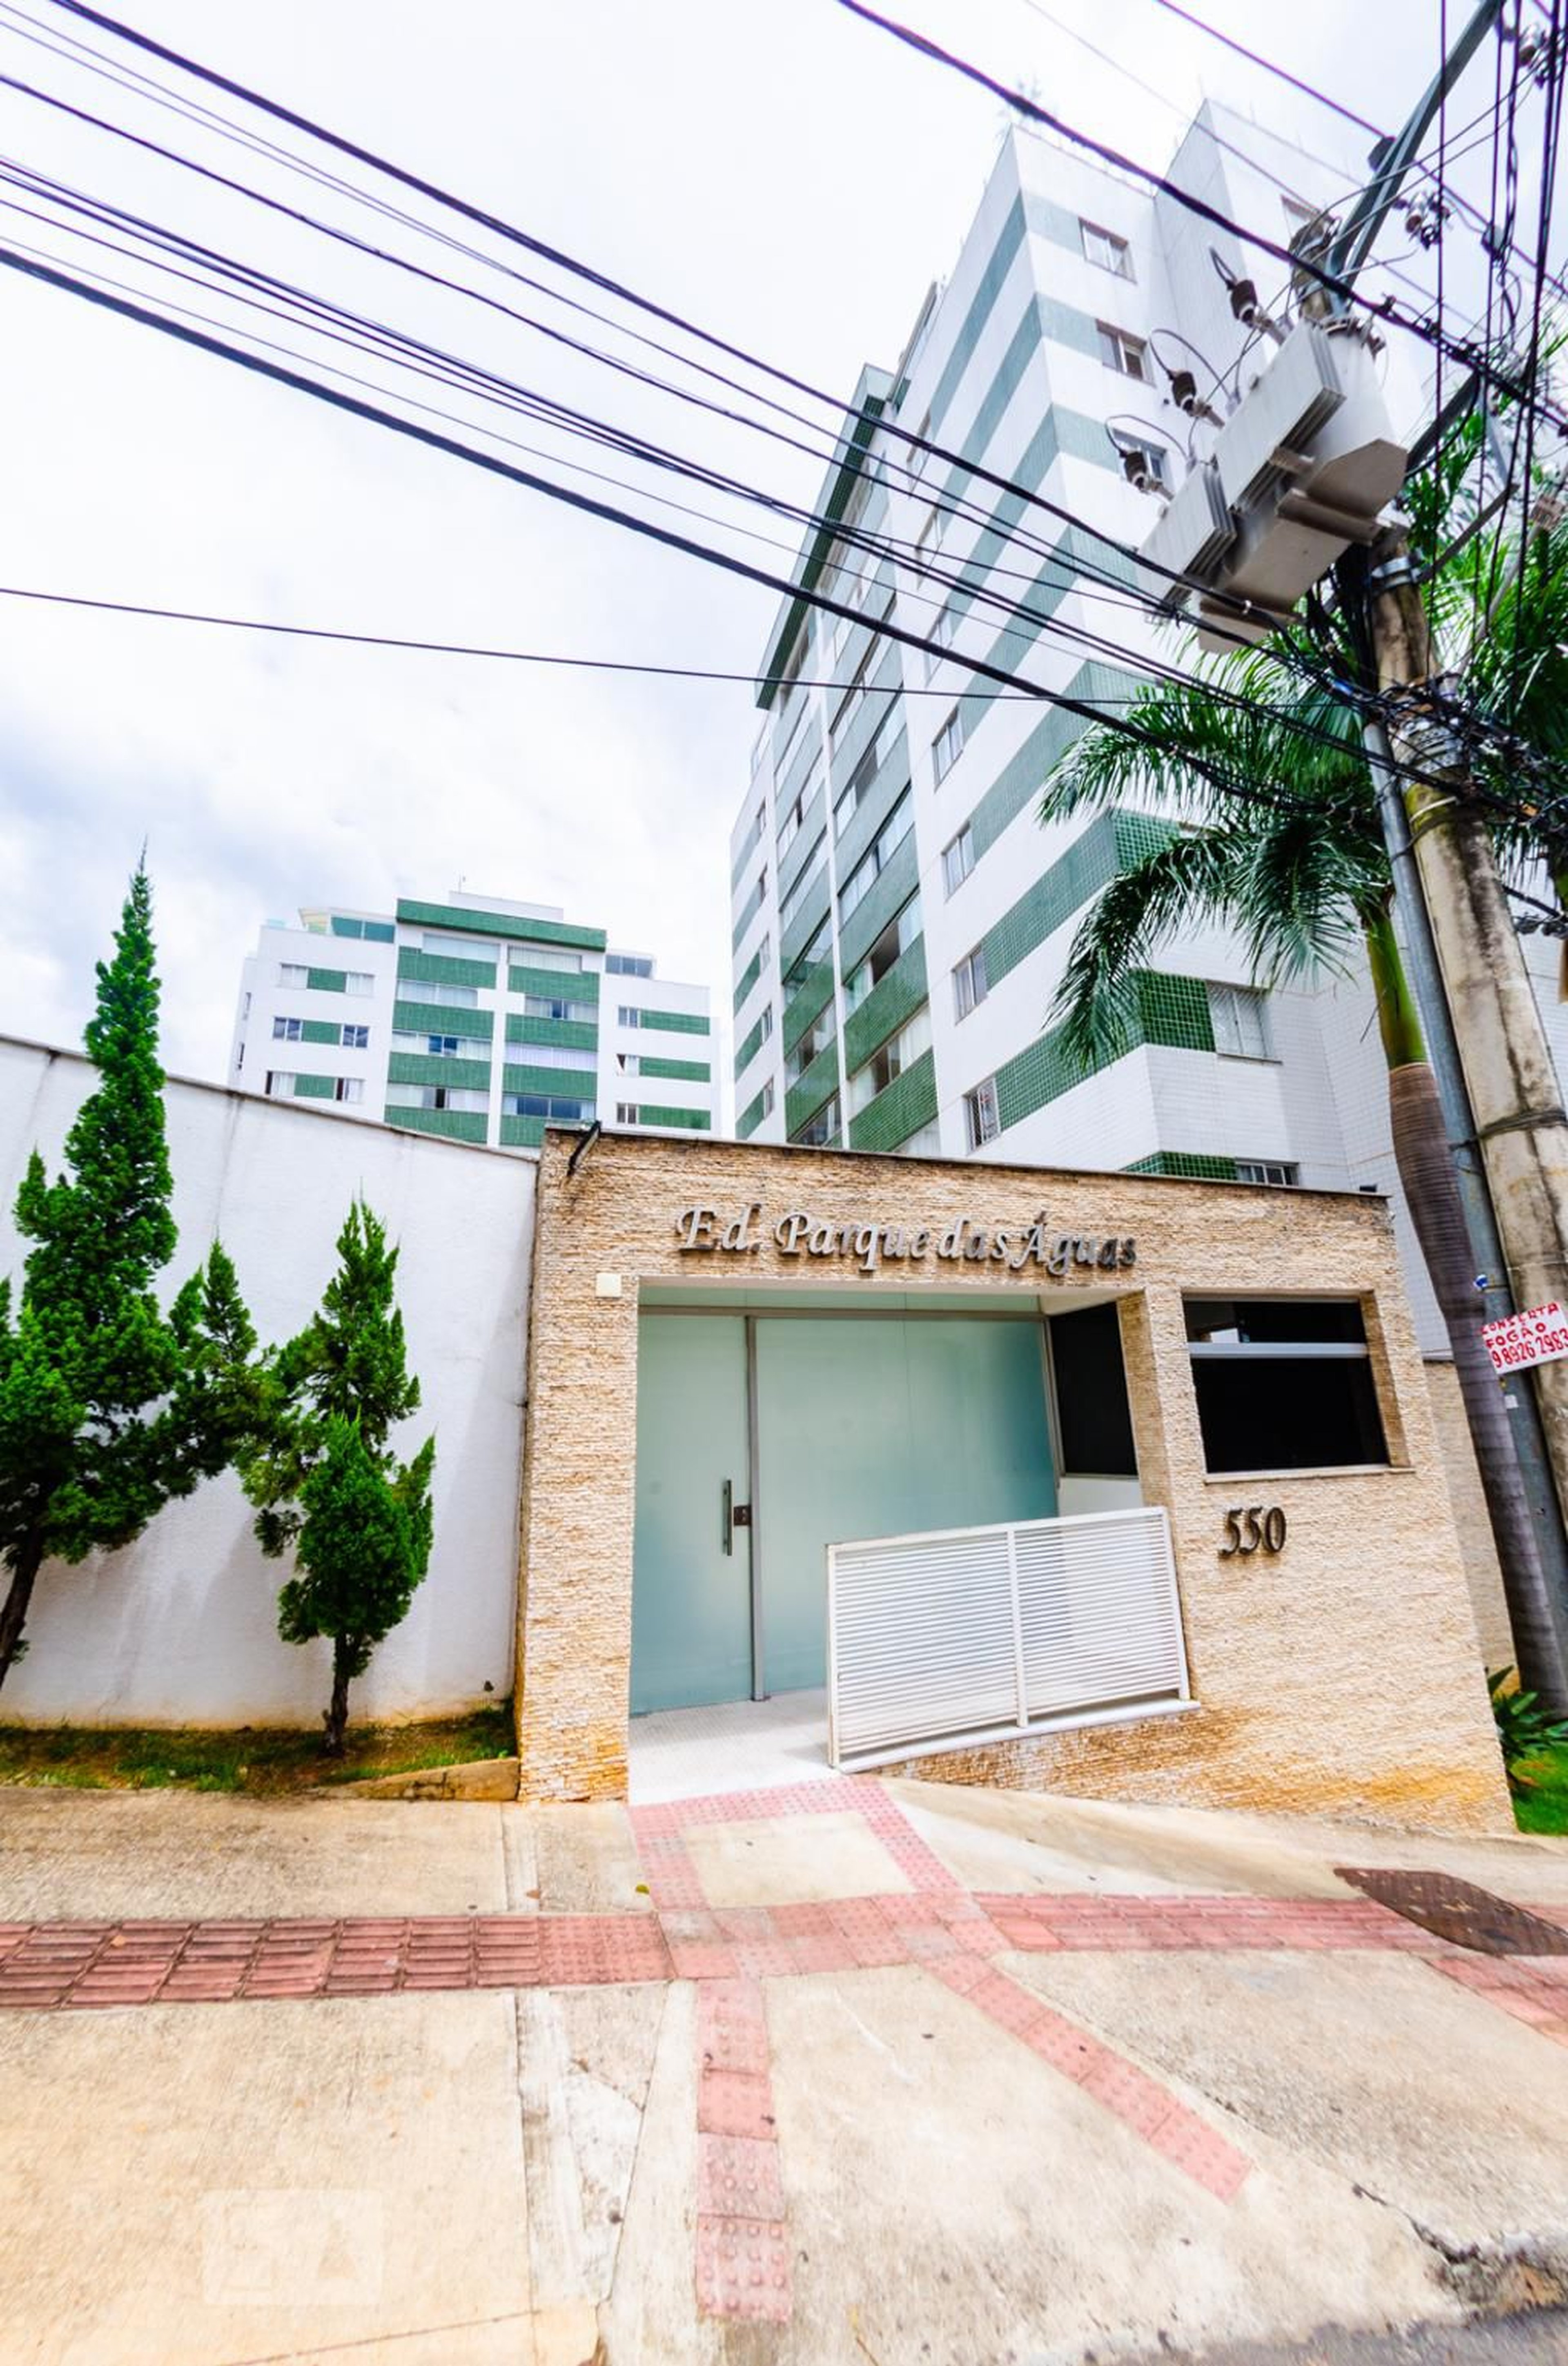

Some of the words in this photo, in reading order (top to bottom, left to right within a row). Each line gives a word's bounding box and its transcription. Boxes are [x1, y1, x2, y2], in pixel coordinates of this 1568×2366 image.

[676, 1203, 763, 1255] Ed.
[775, 1210, 930, 1272] Parque
[938, 1216, 1009, 1260] das
[1009, 1210, 1138, 1276] Águas
[1492, 1341, 1536, 1368] 98926
[1218, 1506, 1286, 1559] 550
